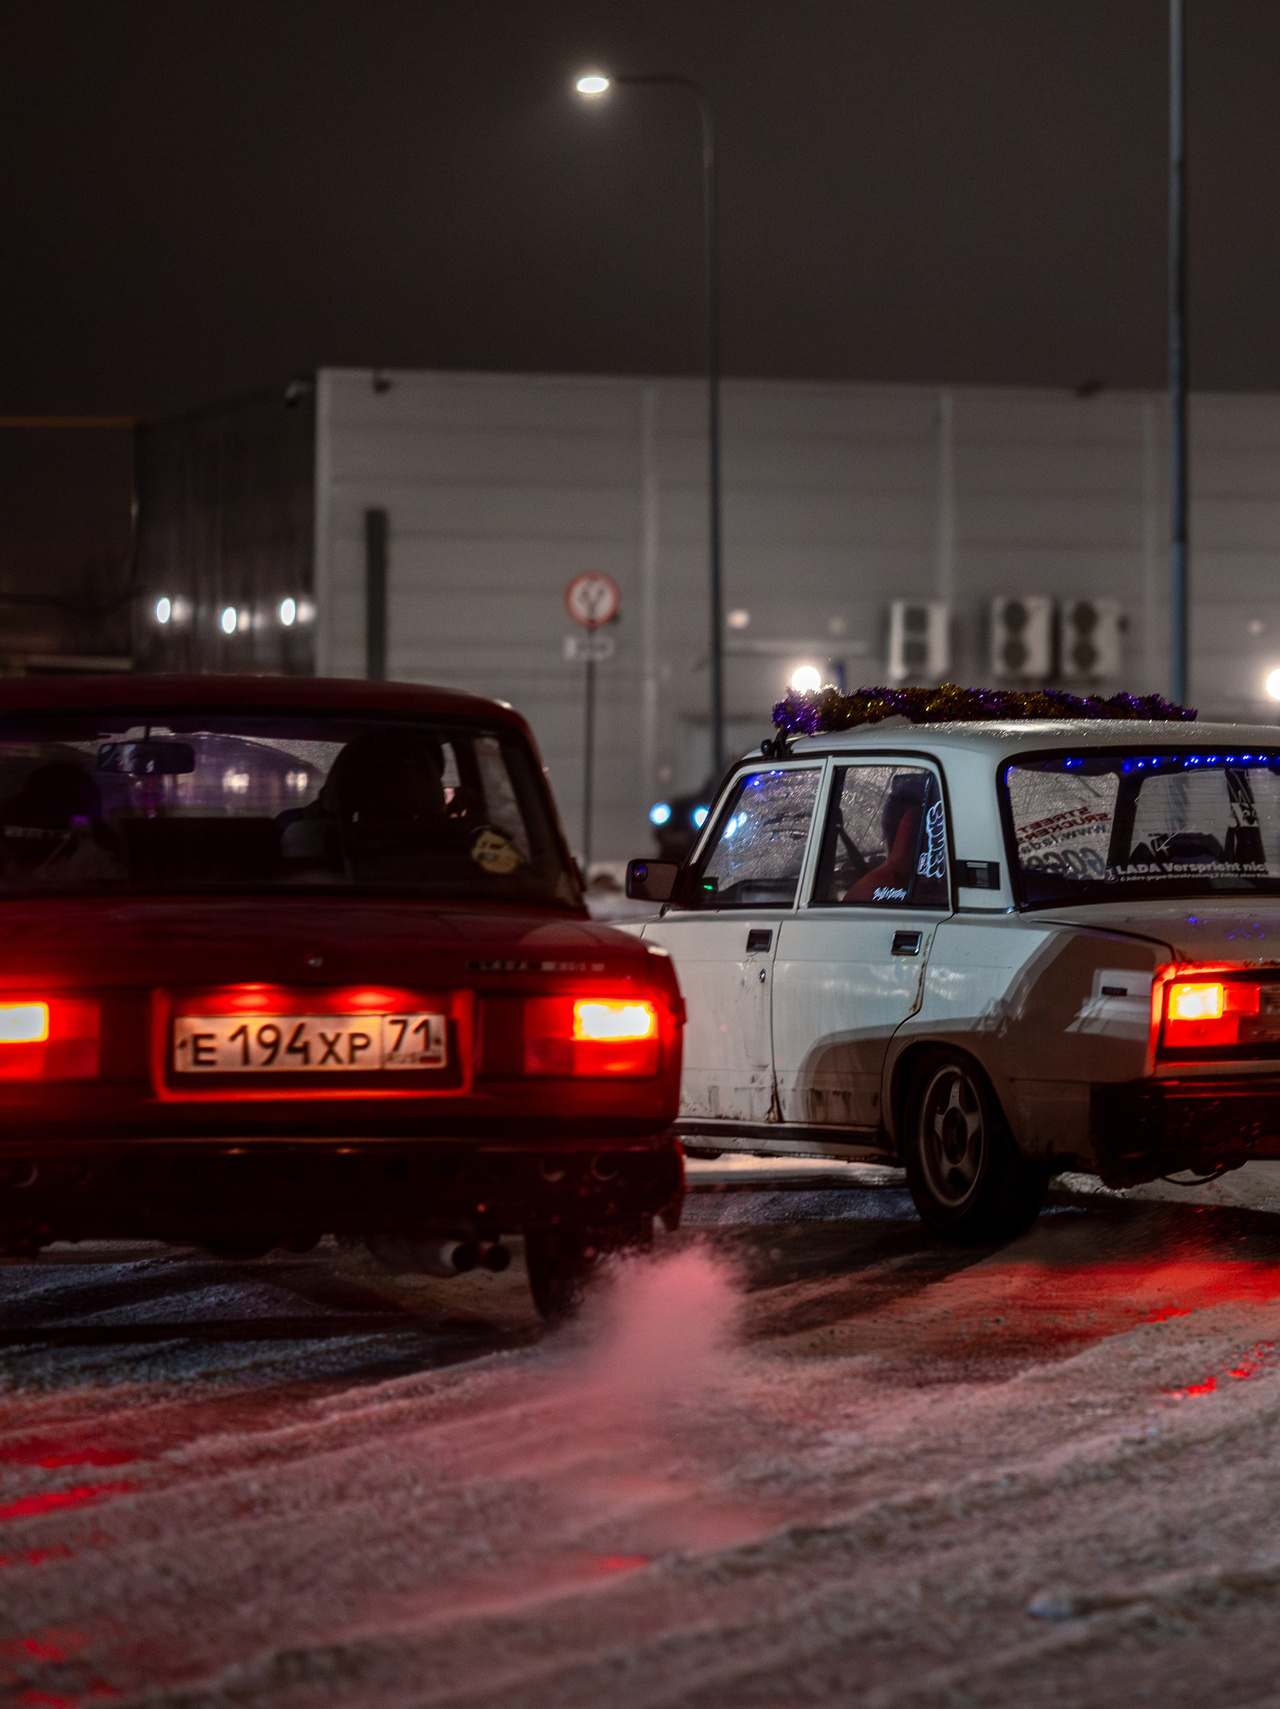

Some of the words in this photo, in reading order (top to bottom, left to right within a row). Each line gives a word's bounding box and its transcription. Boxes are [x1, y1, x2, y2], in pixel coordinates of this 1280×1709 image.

[1115, 863, 1161, 875] LADA
[1162, 861, 1241, 873] Verspricht
[1243, 861, 1276, 873] nic
[388, 1017, 432, 1052] 71
